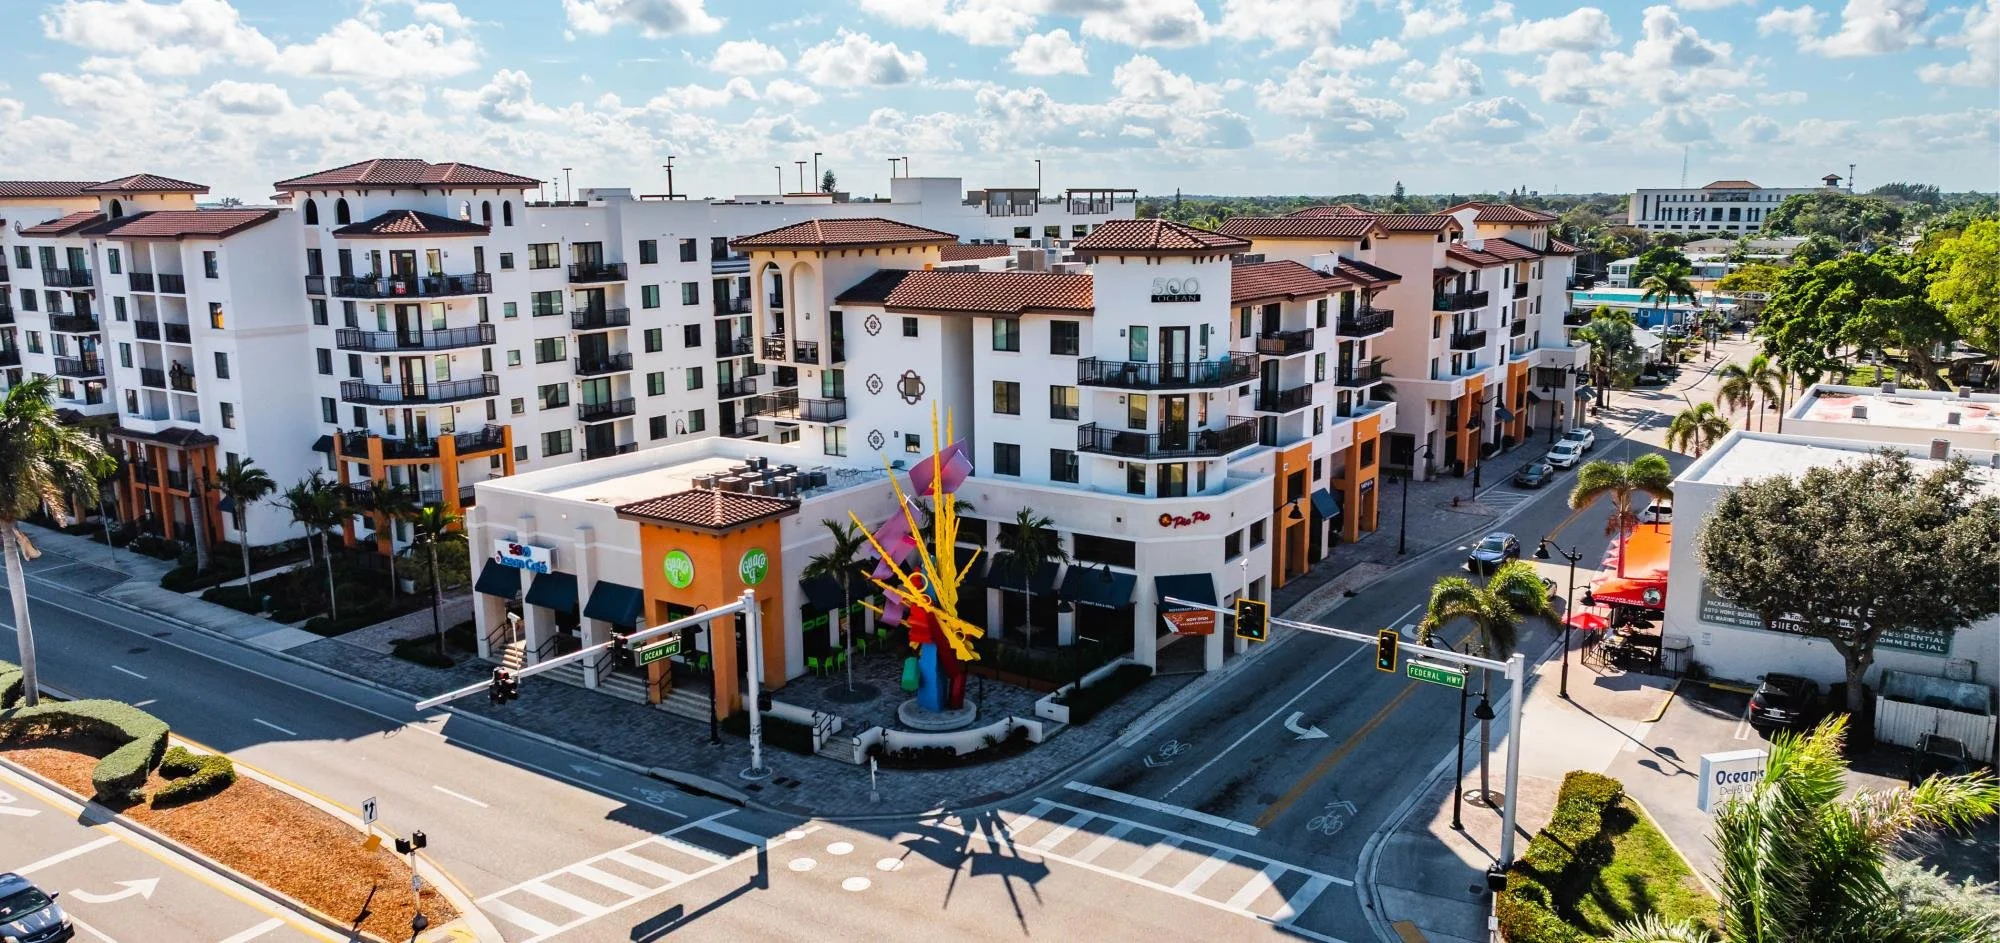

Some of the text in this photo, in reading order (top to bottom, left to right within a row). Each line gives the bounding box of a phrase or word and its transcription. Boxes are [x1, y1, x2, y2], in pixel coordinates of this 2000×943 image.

[1152, 277, 1199, 295] 500
[644, 644, 677, 661] OCEAN AVE
[1877, 637, 1945, 652] OMMERCIAL
[1410, 667, 1461, 685] FEDERAL HWY
